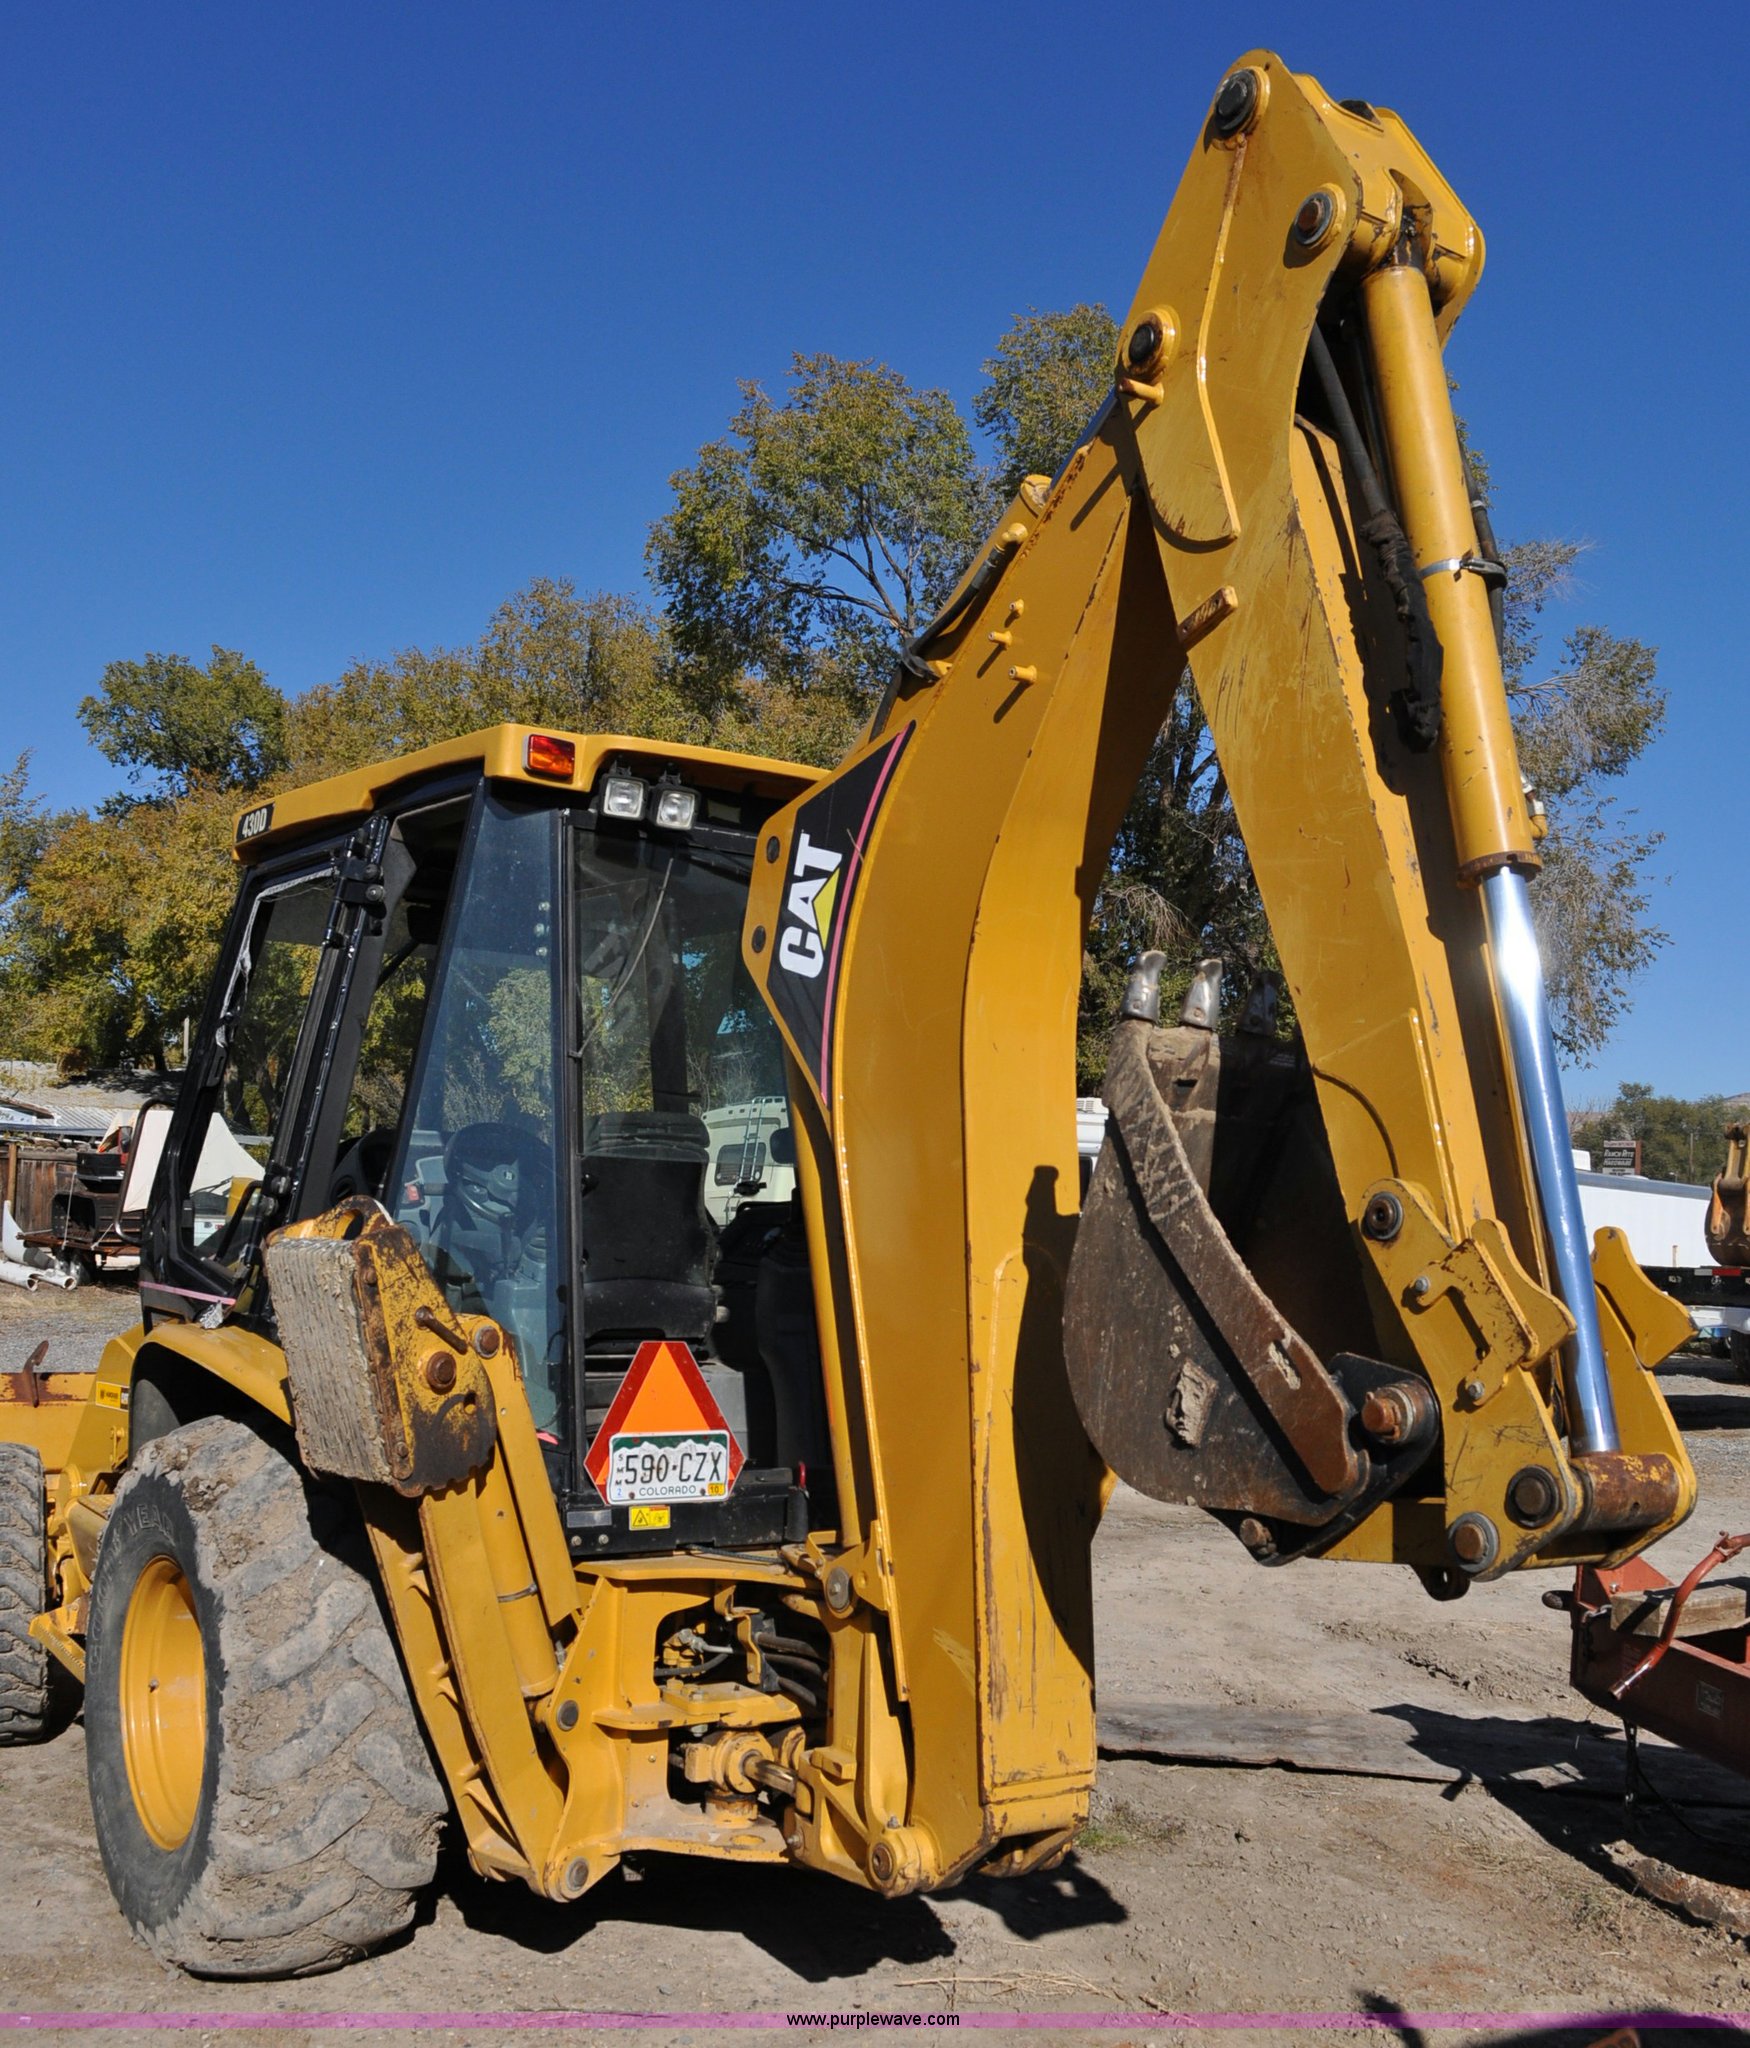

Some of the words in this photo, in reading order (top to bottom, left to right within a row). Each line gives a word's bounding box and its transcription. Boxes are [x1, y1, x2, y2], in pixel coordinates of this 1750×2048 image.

[242, 808, 268, 838] 430D
[779, 832, 843, 979] CAT
[639, 1485, 697, 1496] COLORADO
[709, 1486, 719, 1494] 10
